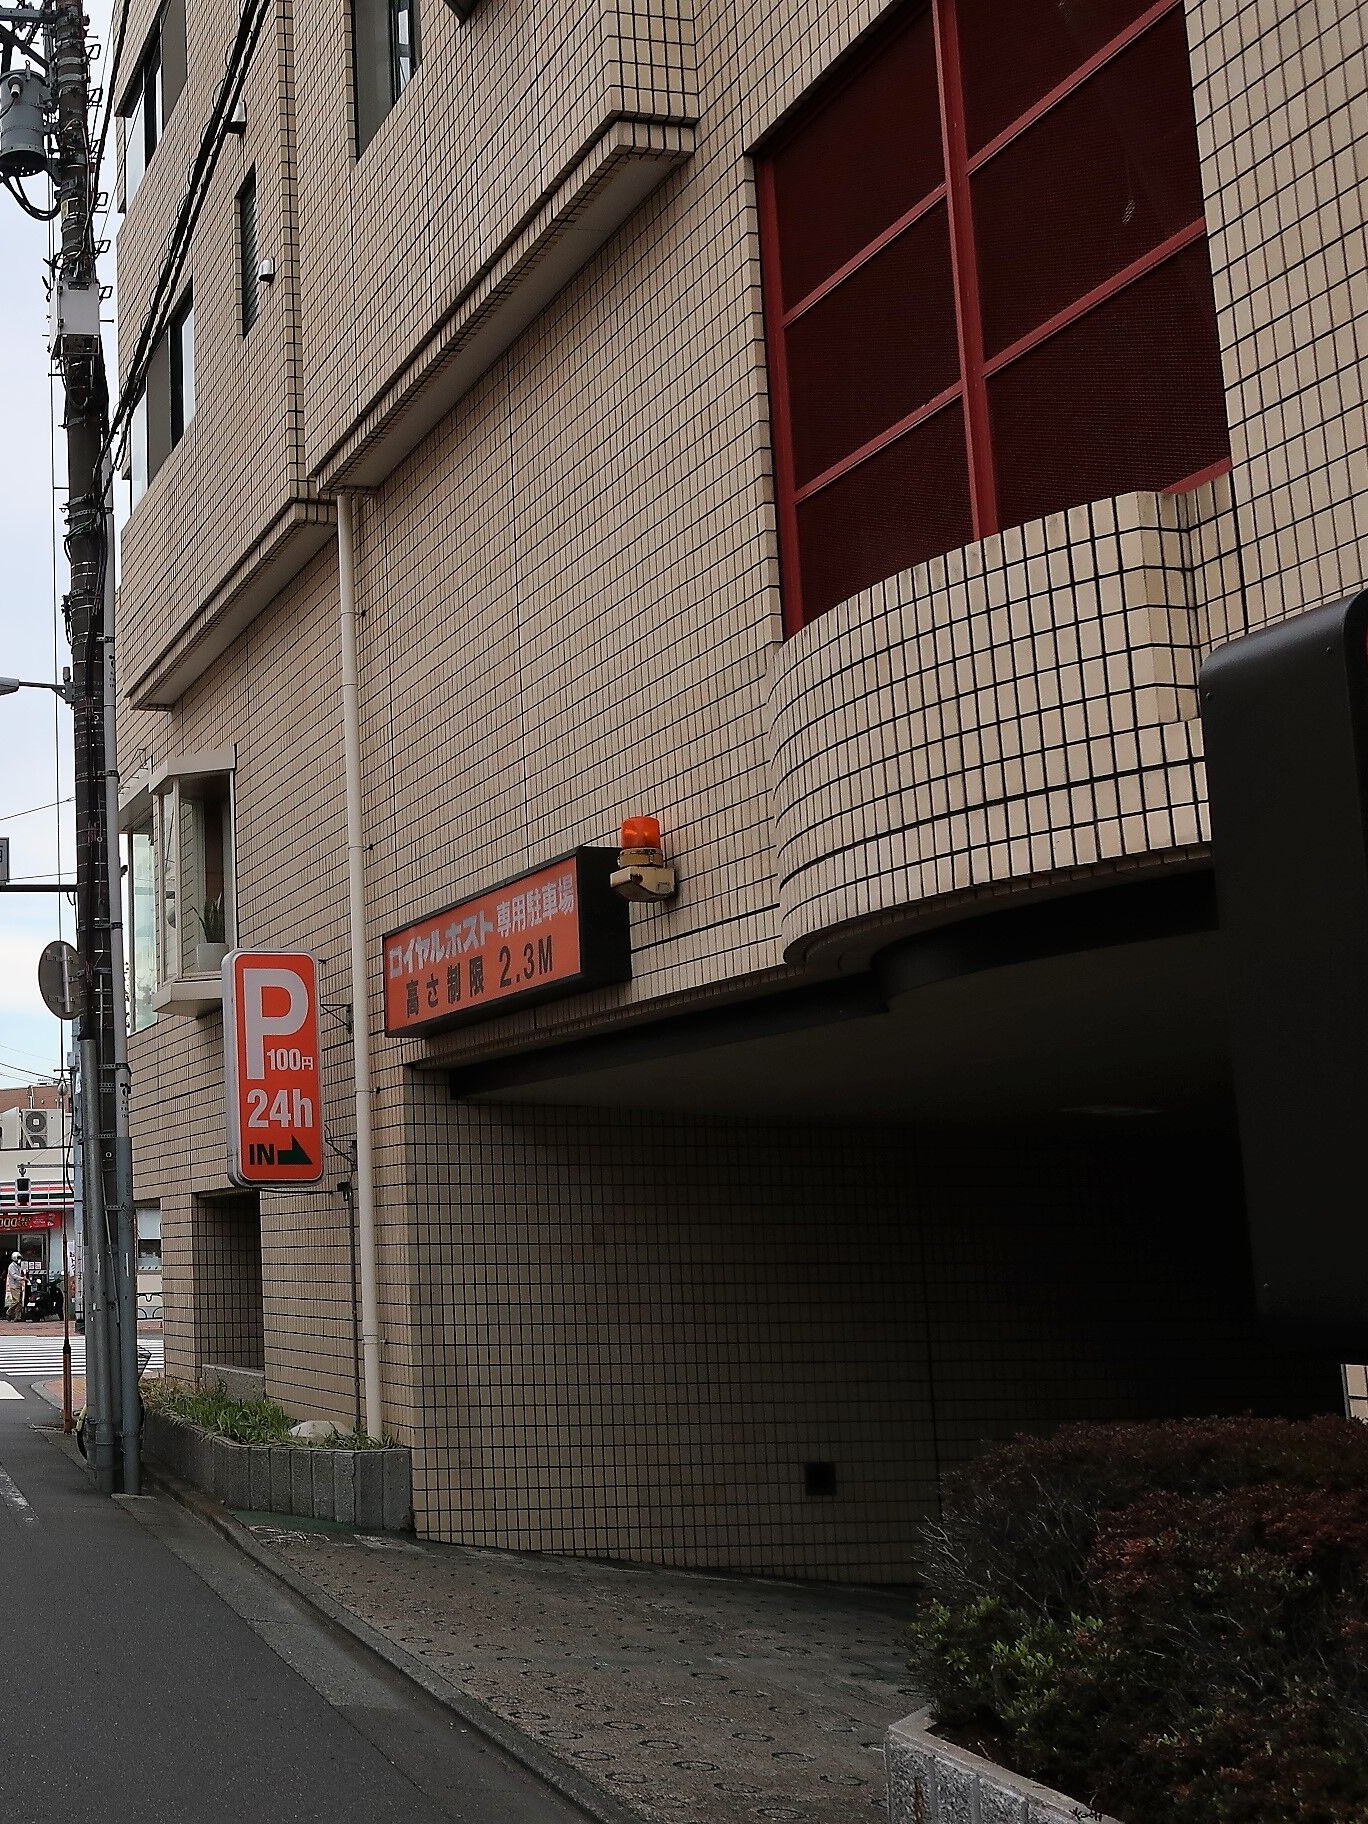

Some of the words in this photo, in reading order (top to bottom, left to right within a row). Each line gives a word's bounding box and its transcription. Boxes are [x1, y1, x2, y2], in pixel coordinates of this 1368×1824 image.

[405, 954, 485, 1018] 高さ制限
[499, 934, 553, 989] 2.3M
[243, 968, 309, 1080] P
[266, 1049, 314, 1071] 100円
[247, 1089, 313, 1128] 24h
[248, 1143, 276, 1166] IN
